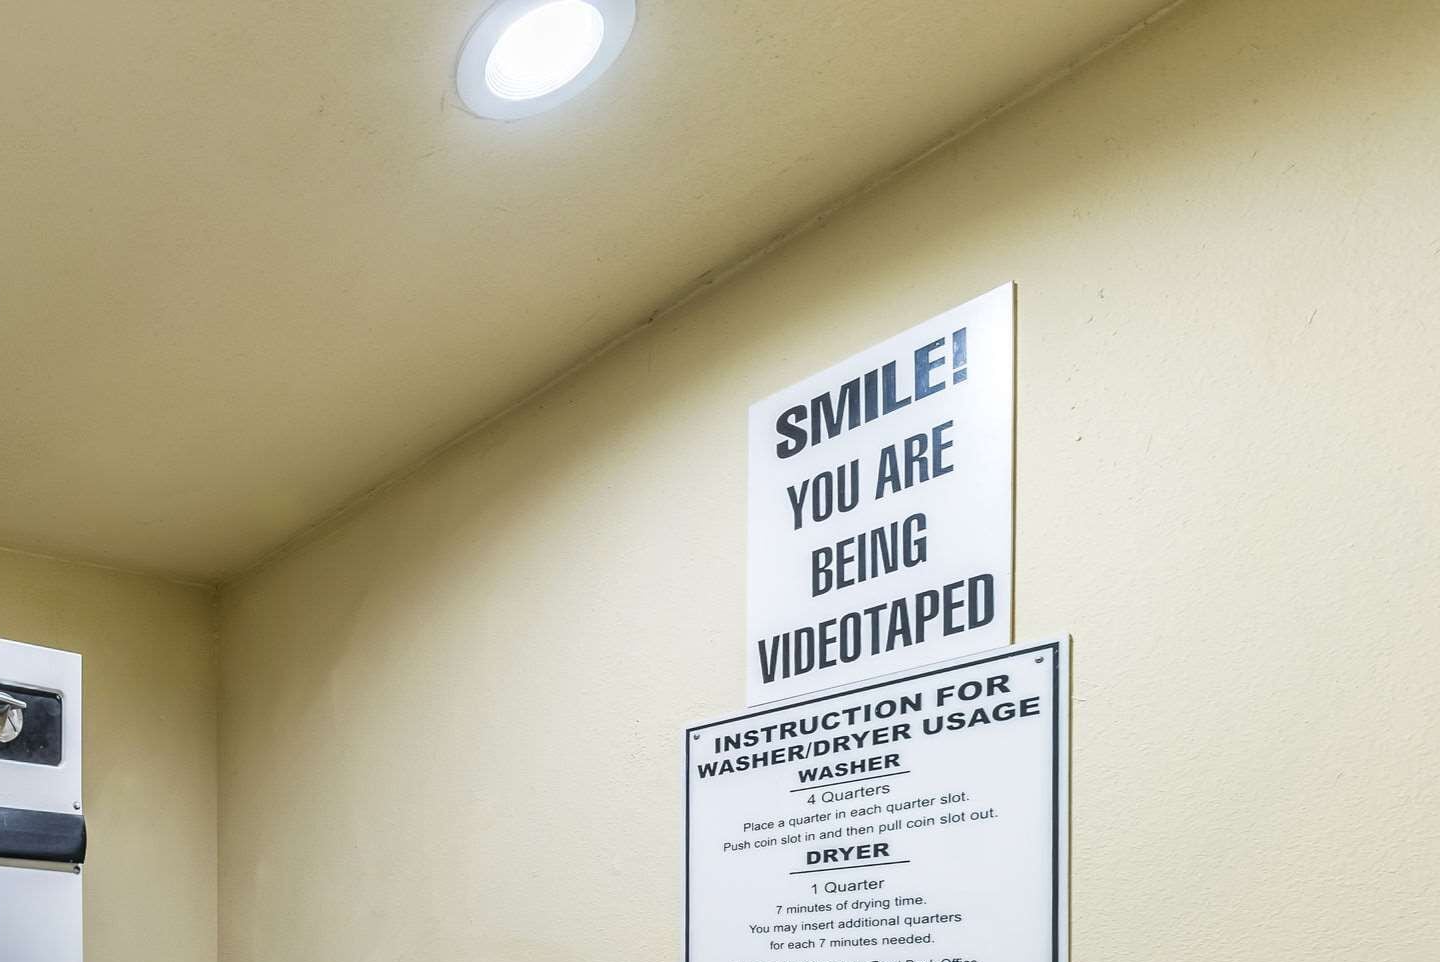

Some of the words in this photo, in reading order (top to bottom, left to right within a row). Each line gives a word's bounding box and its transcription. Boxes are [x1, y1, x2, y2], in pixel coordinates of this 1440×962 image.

[776, 327, 967, 459] SMILE!
[787, 459, 859, 531] YOU
[875, 420, 954, 500] ARE
[812, 512, 927, 597] BEING
[758, 573, 994, 684] VIDEOTAPED
[715, 693, 922, 754] INSTRUCTION
[937, 674, 1011, 707] FOR
[698, 723, 912, 779] WASHER/DRYER
[923, 696, 1041, 736] USAGE
[798, 753, 901, 783] WASHER
[743, 821, 775, 832] Place
[778, 820, 785, 828] a
[788, 812, 832, 828] quarter
[835, 809, 846, 820] in
[850, 804, 882, 818] each
[886, 797, 937, 815] quarter
[940, 791, 971, 805] slot.
[807, 794, 816, 805] 4
[821, 784, 891, 804] Quarters
[723, 840, 751, 852] Push
[754, 836, 777, 848] coin
[780, 833, 802, 845] slot
[805, 831, 815, 841] in
[819, 828, 843, 840] and
[846, 825, 875, 836] then
[878, 820, 902, 835] pull
[906, 816, 935, 829] coin
[940, 812, 966, 825] slot
[970, 808, 999, 821] out.
[806, 842, 890, 865] DRYER
[776, 905, 783, 915] 7
[786, 903, 833, 915] minutes
[835, 900, 849, 911] of
[851, 897, 890, 911] drying
[894, 896, 927, 907] time.
[811, 883, 818, 895] 1
[824, 879, 885, 894] Quarter
[749, 924, 770, 934] You
[773, 924, 798, 935] may
[801, 920, 834, 931] insert
[838, 915, 900, 929] additional
[903, 913, 962, 928] quarters
[770, 941, 785, 950] for
[787, 939, 816, 950] each
[819, 938, 826, 948] 7
[829, 936, 878, 948] minutes
[881, 933, 935, 945] needed.
